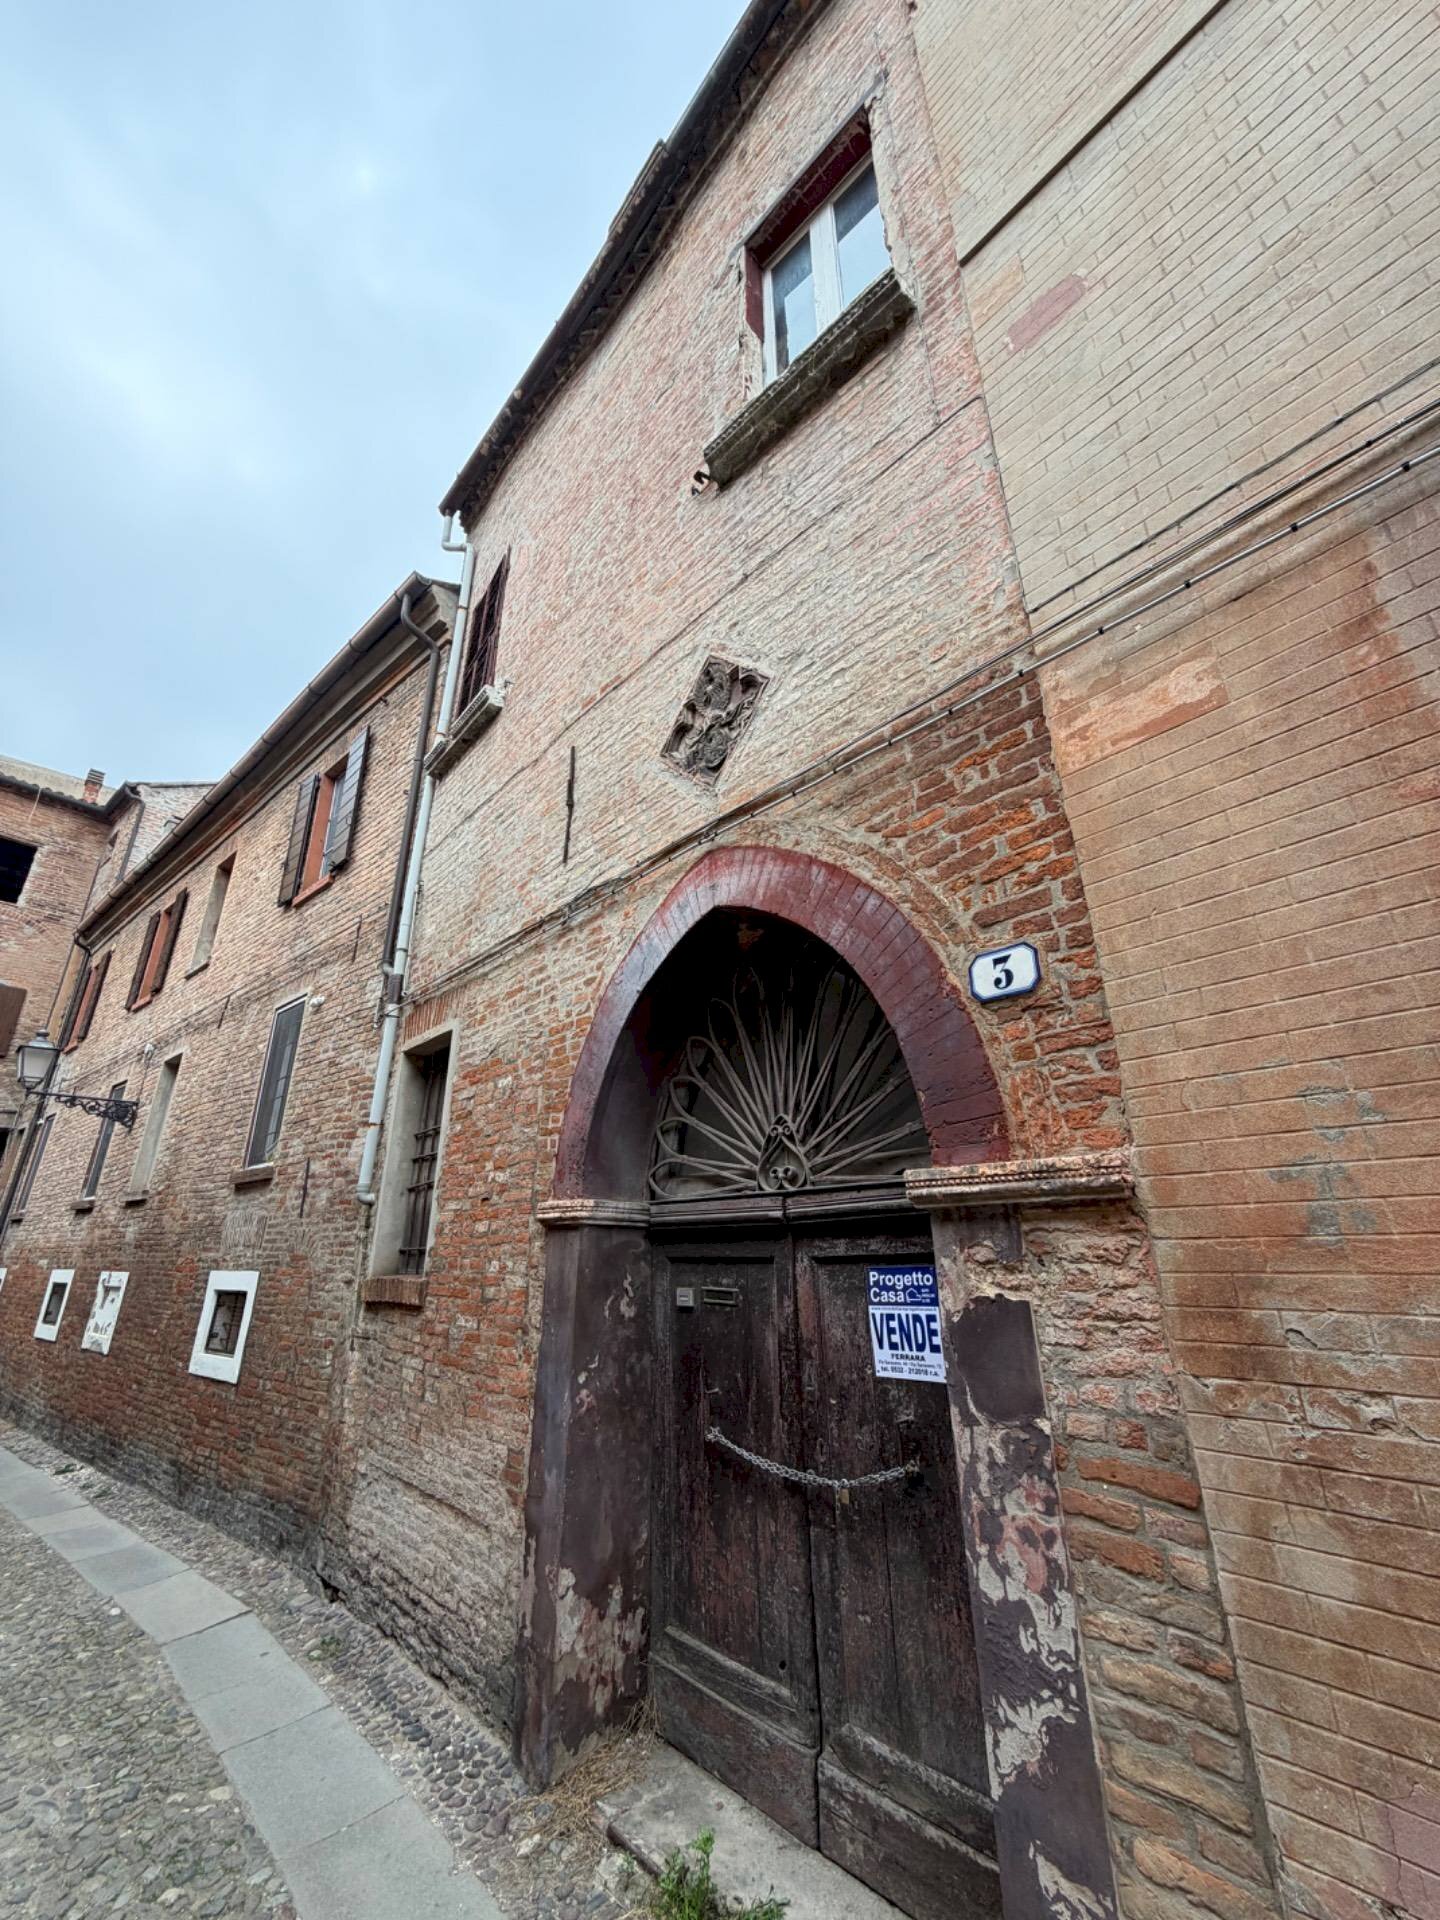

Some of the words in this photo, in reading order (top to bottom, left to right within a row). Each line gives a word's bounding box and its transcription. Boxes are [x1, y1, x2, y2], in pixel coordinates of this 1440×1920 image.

[992, 954, 1014, 990] 3
[869, 1272, 933, 1289] Progetto
[870, 1288, 904, 1302] Casa
[871, 1313, 941, 1353] VENDE
[891, 1353, 925, 1361] FERRARA
